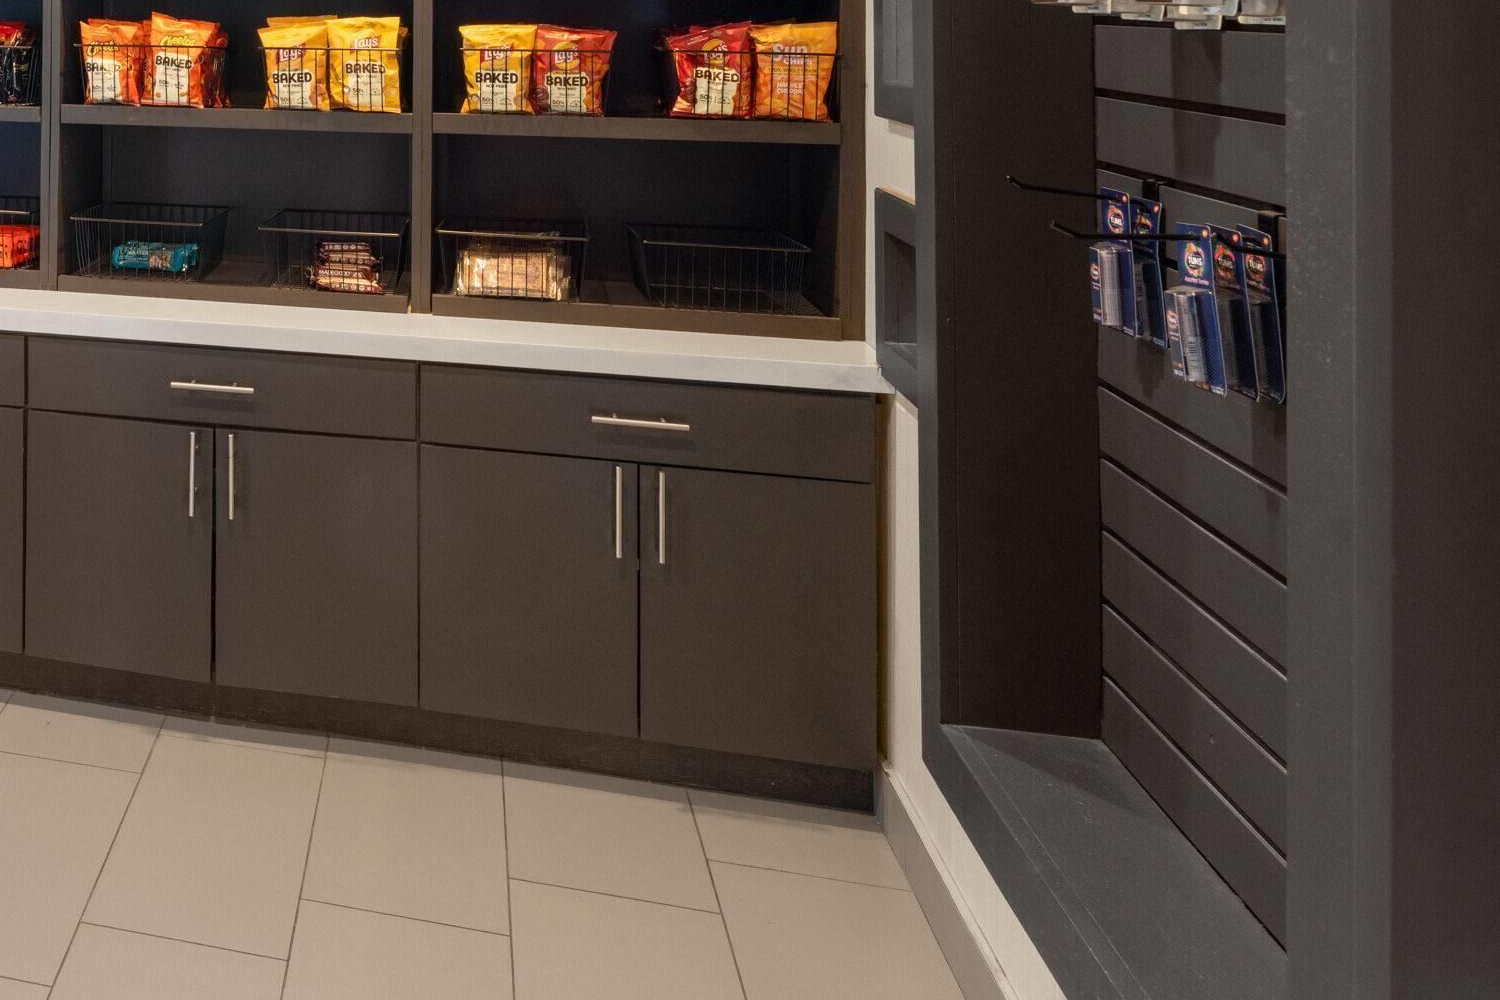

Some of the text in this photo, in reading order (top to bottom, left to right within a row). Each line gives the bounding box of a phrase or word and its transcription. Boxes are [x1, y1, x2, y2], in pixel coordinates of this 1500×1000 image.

[159, 35, 196, 48] Cheetos
[155, 55, 193, 69] BAKED
[345, 63, 386, 74] BAKED
[272, 72, 312, 84] BAKED
[475, 72, 519, 84] BAKED
[546, 75, 589, 87] BAKED
[695, 69, 741, 83] BAKED
[1188, 255, 1203, 267] TUMS
